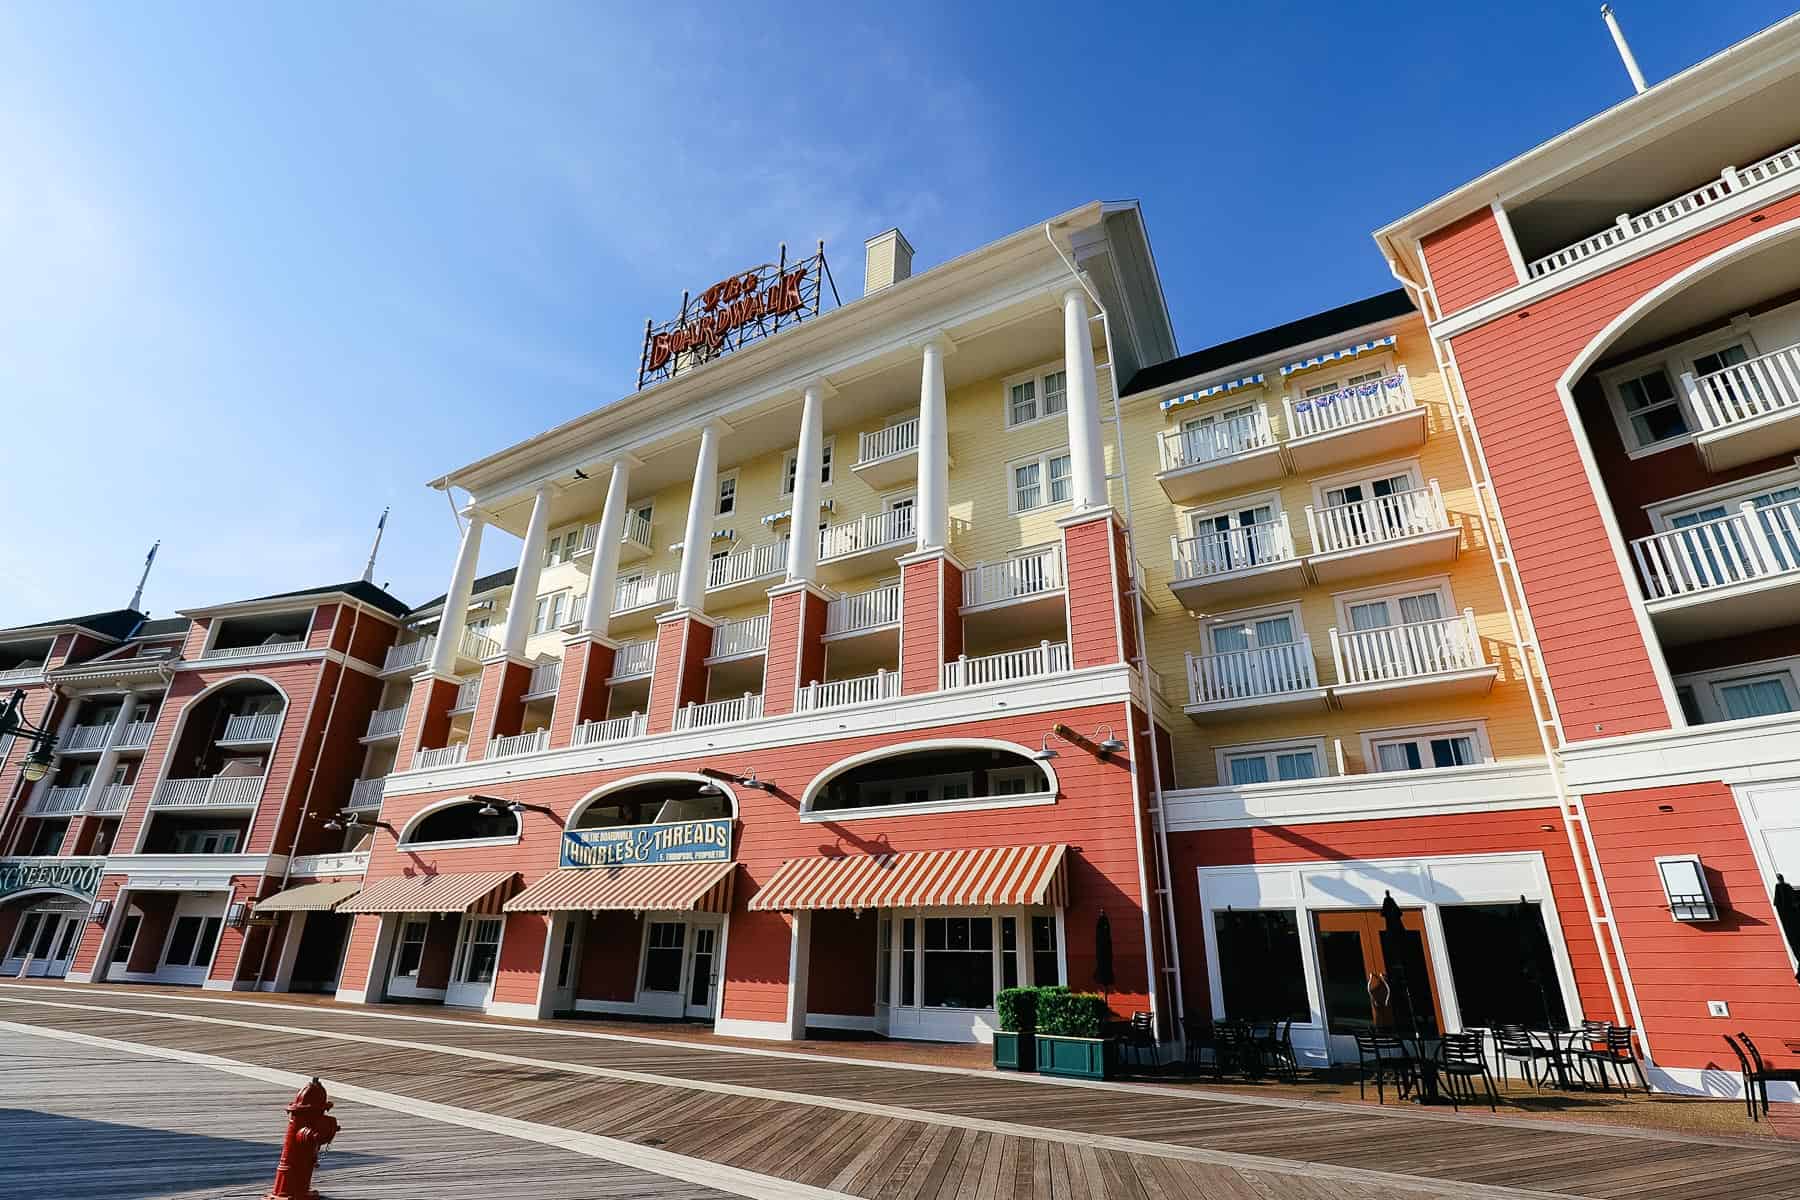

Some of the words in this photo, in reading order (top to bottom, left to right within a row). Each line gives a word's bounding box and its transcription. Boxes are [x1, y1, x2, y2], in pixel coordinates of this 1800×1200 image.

[649, 268, 807, 371] BOARDWALK
[565, 839, 634, 865] THIMBLES
[635, 830, 656, 861] &
[654, 823, 727, 848] THREADS
